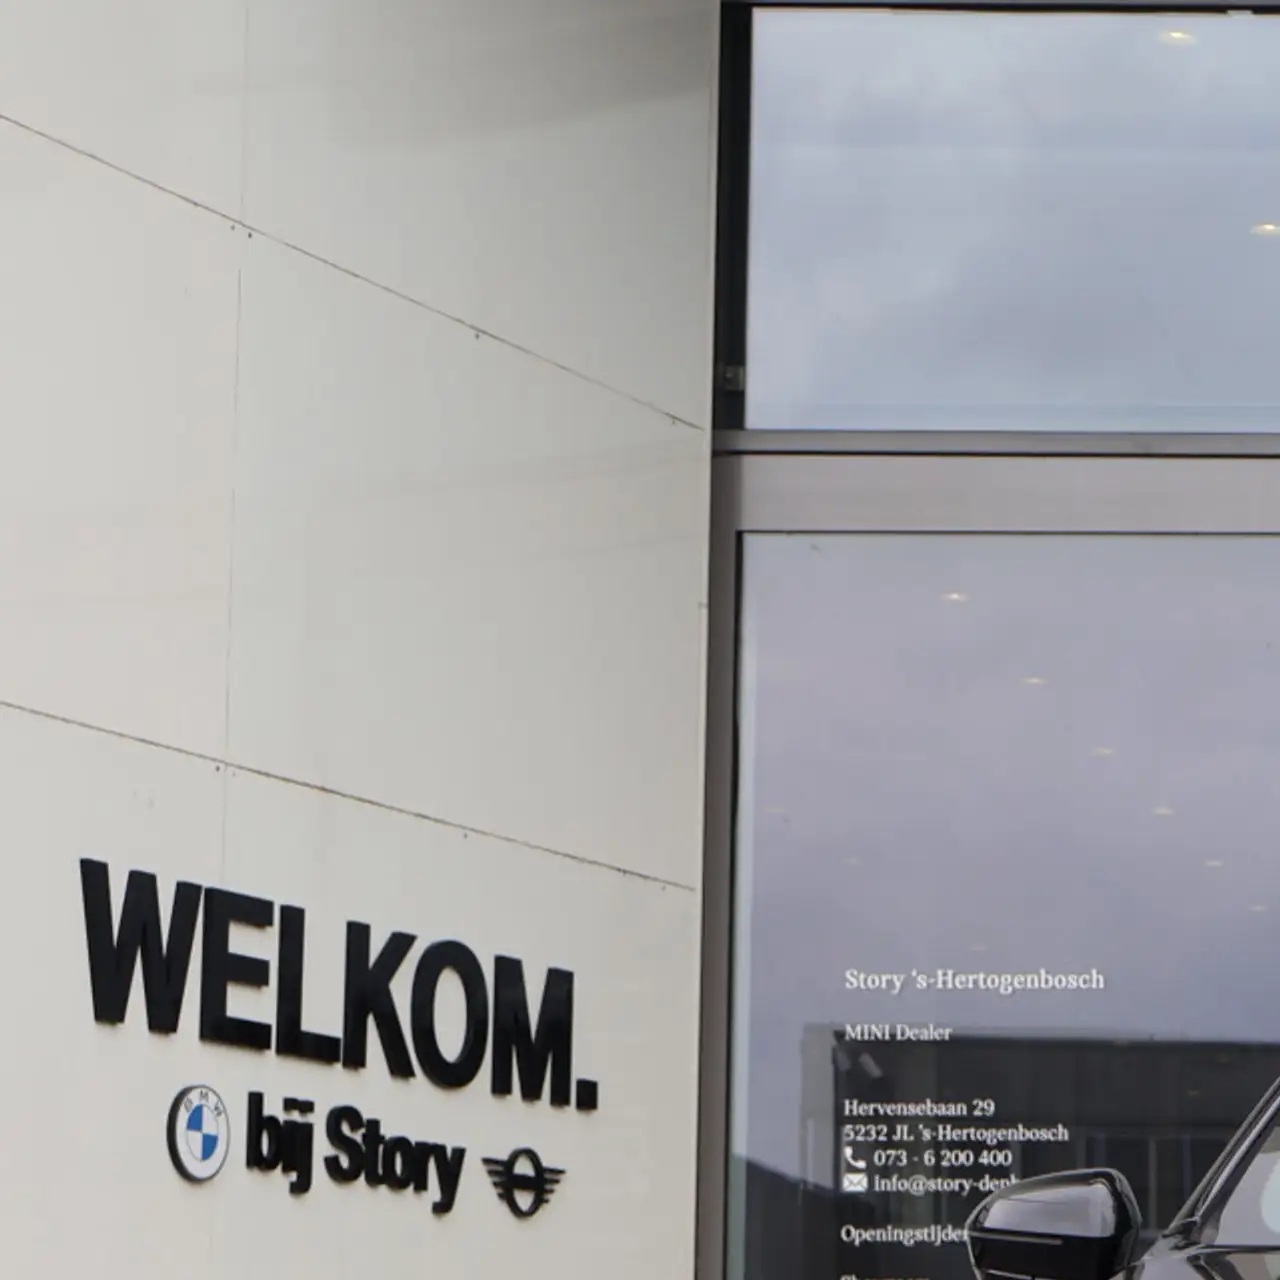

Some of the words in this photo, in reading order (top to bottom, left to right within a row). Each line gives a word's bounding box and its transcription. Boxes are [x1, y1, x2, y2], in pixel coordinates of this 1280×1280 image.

[80, 858, 598, 1111] WELKOM.
[844, 968, 906, 995] Story
[844, 1024, 891, 1041] MINI
[895, 1024, 953, 1041] Dealer
[843, 1099, 967, 1117] Hervensebaan
[972, 1099, 996, 1117] 29
[843, 1124, 888, 1142] 5232
[892, 1124, 915, 1142] JL
[246, 1092, 314, 1196] bij
[323, 1105, 466, 1216] Story
[873, 1150, 908, 1167] 073
[923, 1150, 936, 1167] 6
[939, 1150, 974, 1167] 200
[978, 1150, 1013, 1167] 400
[874, 1173, 1017, 1196] info@story-den
[841, 1225, 968, 1248] Openingstijde
